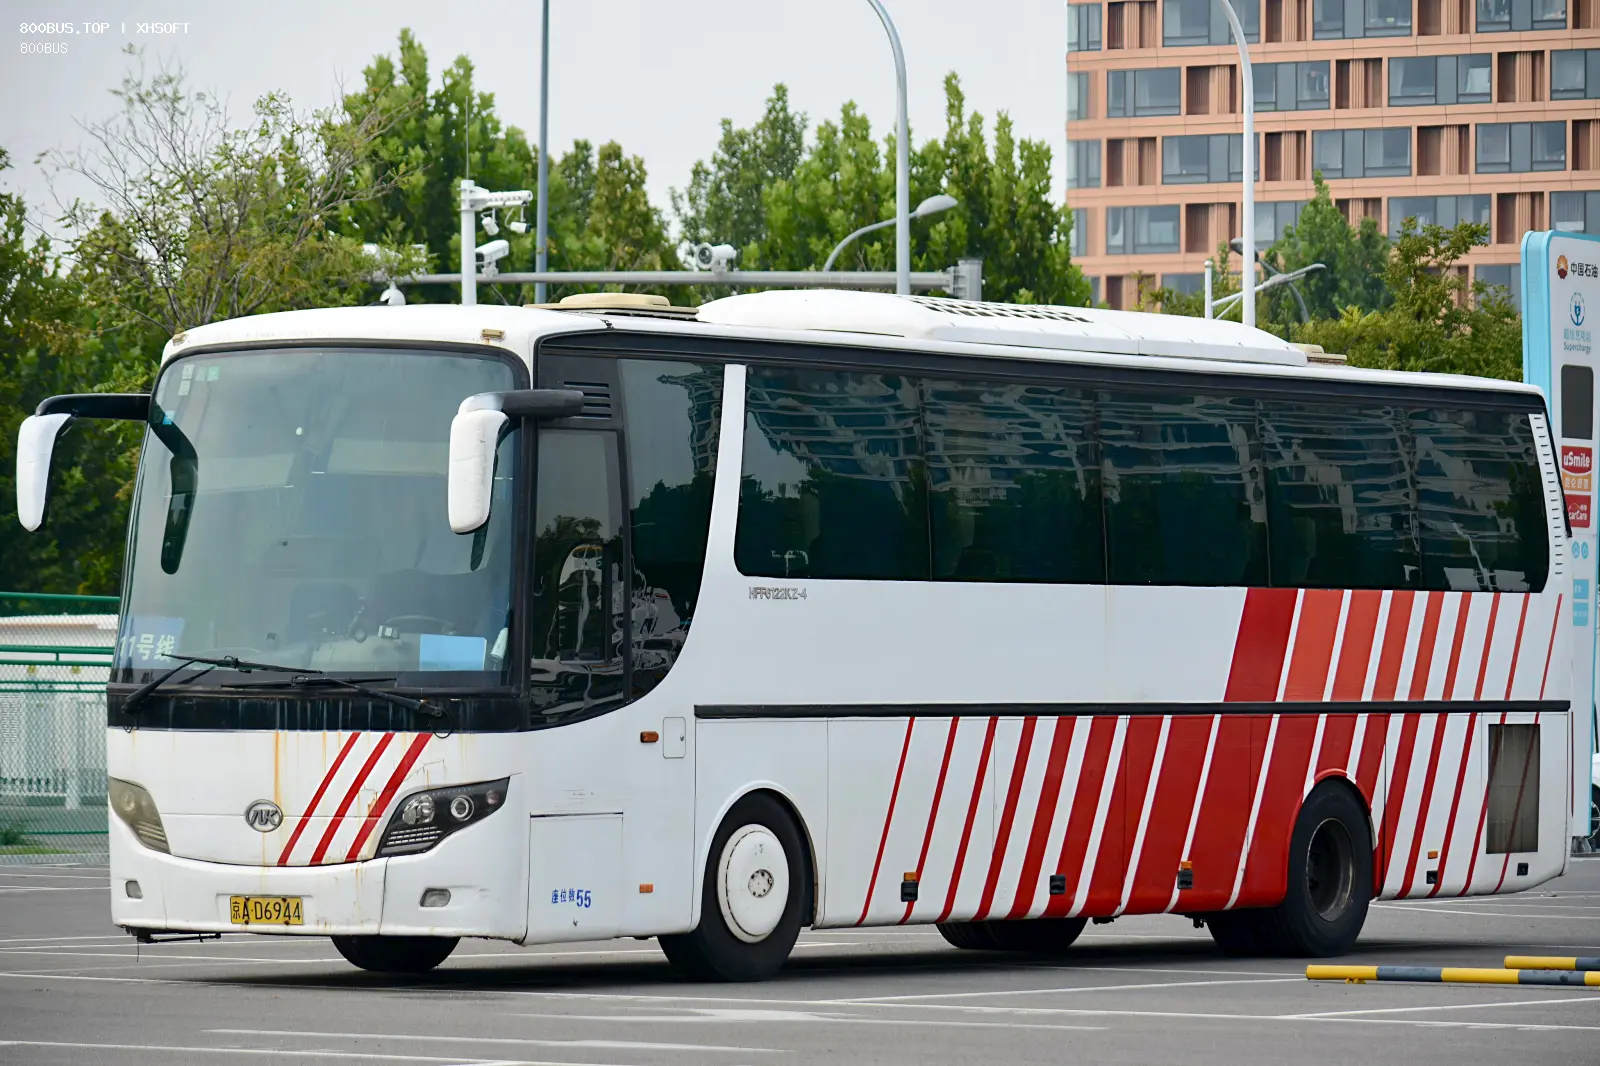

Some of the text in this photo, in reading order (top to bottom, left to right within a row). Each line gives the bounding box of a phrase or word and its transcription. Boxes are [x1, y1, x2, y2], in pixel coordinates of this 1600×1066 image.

[1571, 262, 1598, 278] 中国石油
[1563, 451, 1590, 469] uSmile
[120, 634, 175, 662] 11号线
[576, 889, 592, 908] 55
